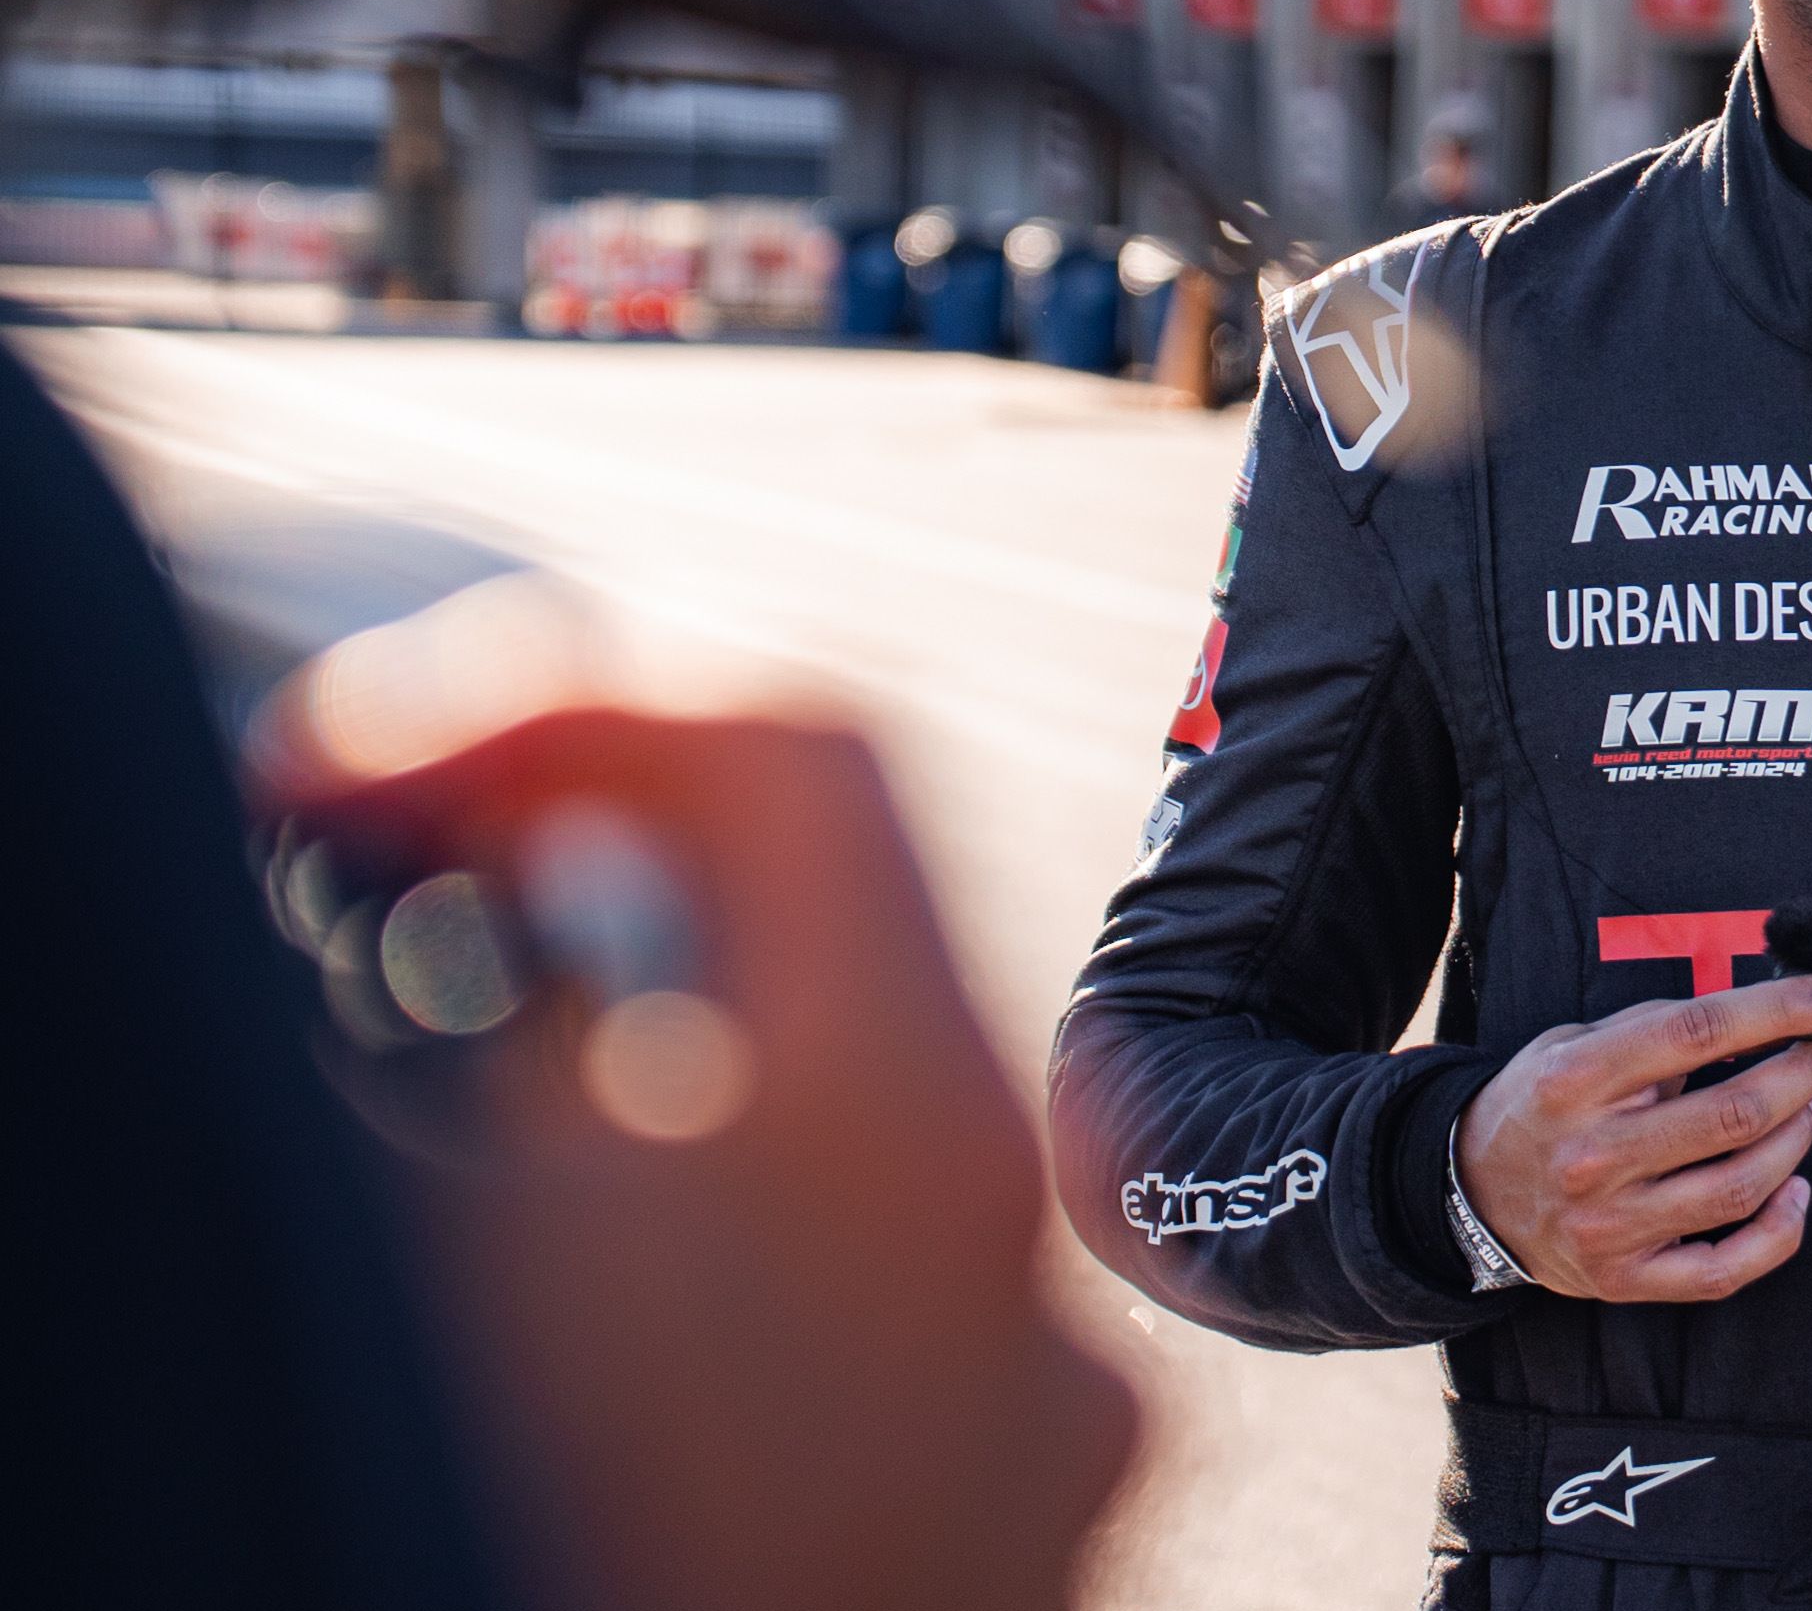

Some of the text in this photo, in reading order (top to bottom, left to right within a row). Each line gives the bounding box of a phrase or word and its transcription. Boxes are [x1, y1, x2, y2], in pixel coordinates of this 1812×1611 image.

[1546, 582, 1720, 650] URBAN
[1592, 748, 1641, 766] kevin
[1645, 746, 1692, 763] reed
[1602, 761, 1807, 783] 704-200-3024
